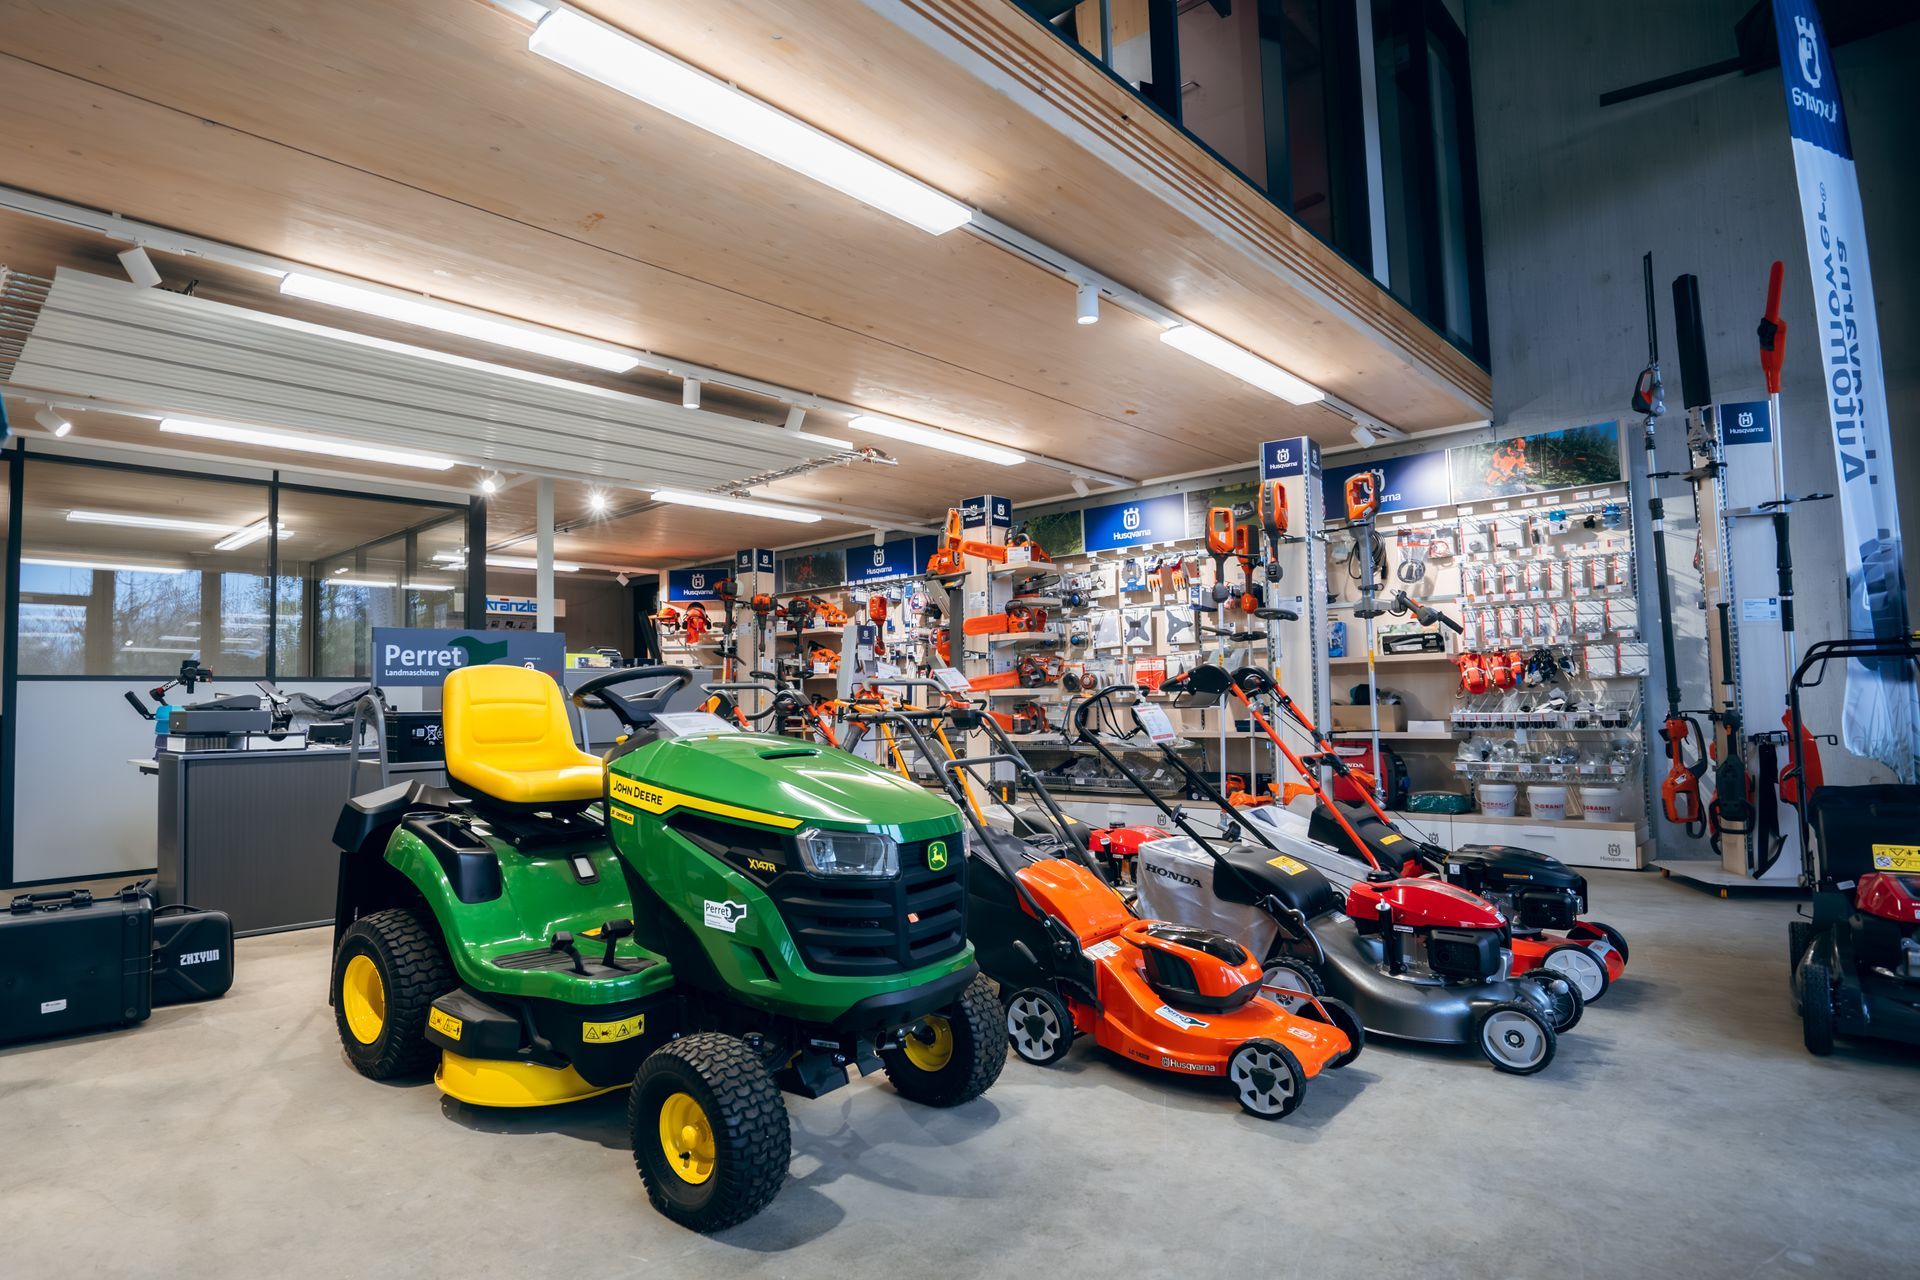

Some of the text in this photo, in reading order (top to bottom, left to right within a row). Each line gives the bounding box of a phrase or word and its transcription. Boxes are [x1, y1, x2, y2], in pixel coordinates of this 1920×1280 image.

[1269, 462, 1298, 470] Husqvarna
[1113, 529, 1152, 541] Husqvarna
[866, 566, 893, 575] Husqvarna
[385, 644, 462, 667] Perret
[385, 669, 440, 677] Landmaschinen
[613, 780, 663, 806] JOHN DEERE
[747, 857, 777, 873] X147R
[1145, 863, 1203, 889] HONDA
[705, 902, 729, 917] Perret
[180, 949, 220, 966] ZHIYUN
[1169, 1058, 1216, 1073] Husqvarna
